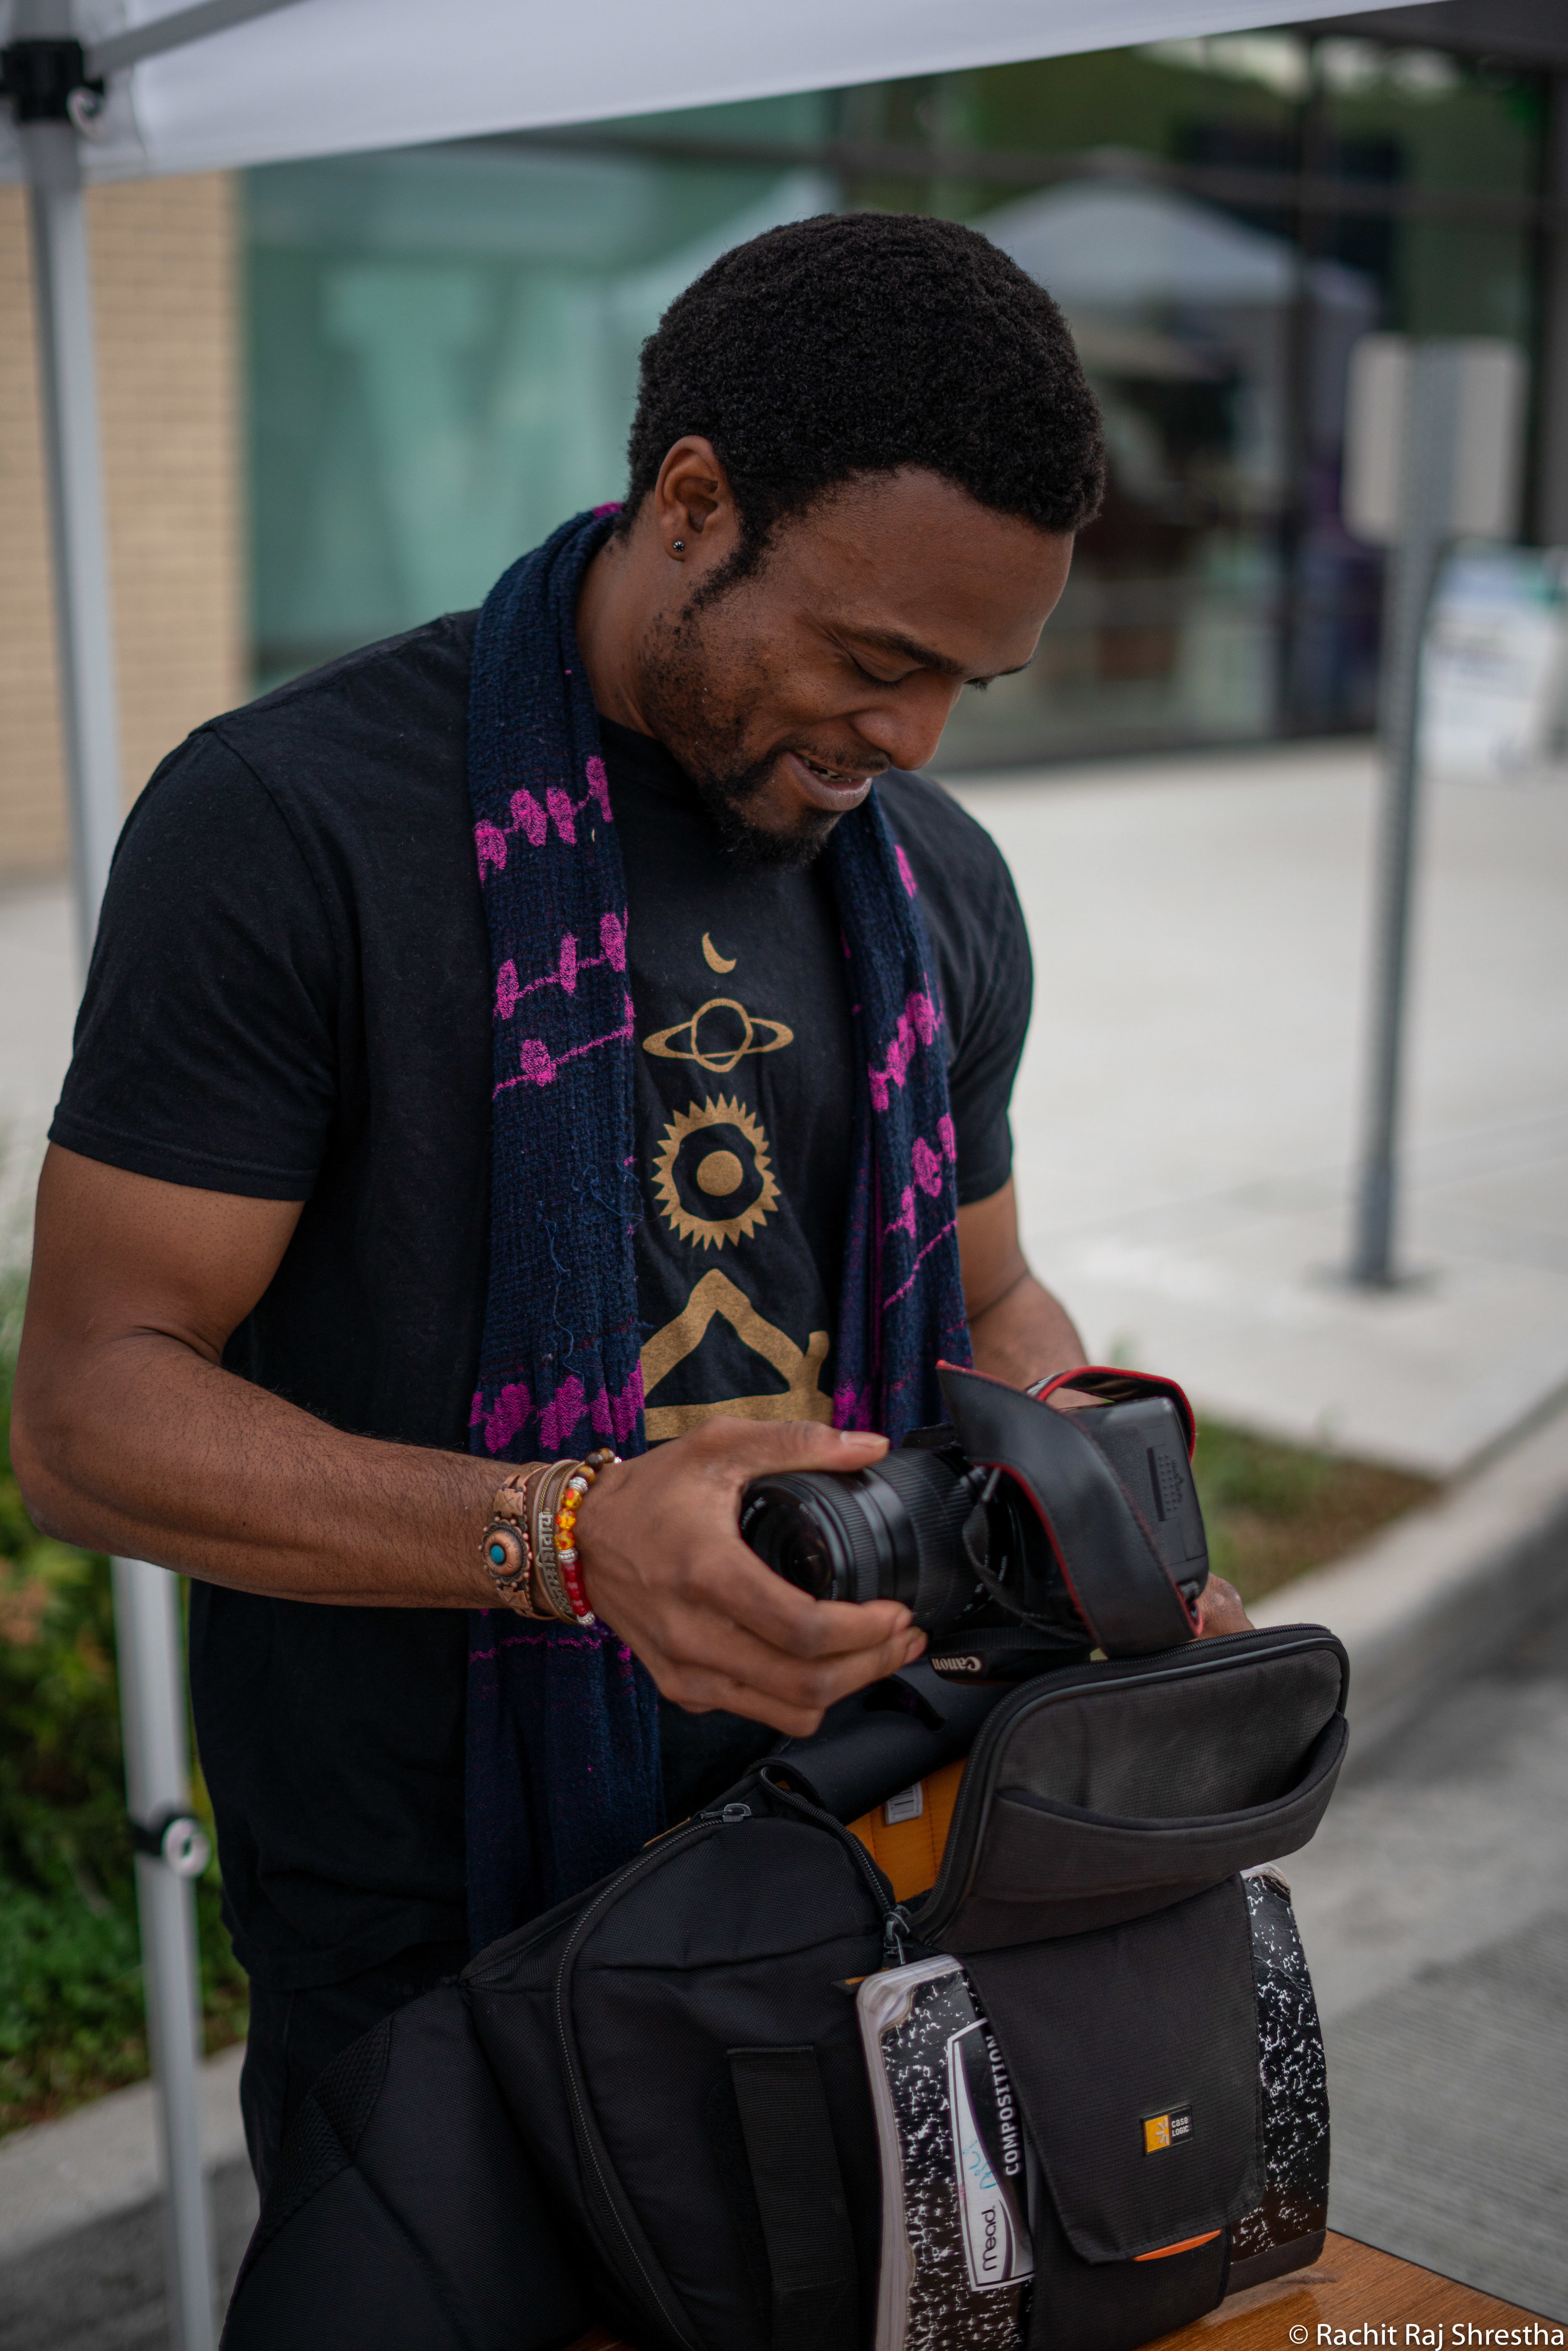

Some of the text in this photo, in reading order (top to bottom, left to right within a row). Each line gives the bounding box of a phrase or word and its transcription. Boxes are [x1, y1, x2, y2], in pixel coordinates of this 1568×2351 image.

[931, 1656, 982, 1671] Canon
[985, 2035, 1020, 2176] COMPOSITION
[1172, 2125, 1189, 2136] LOGIC
